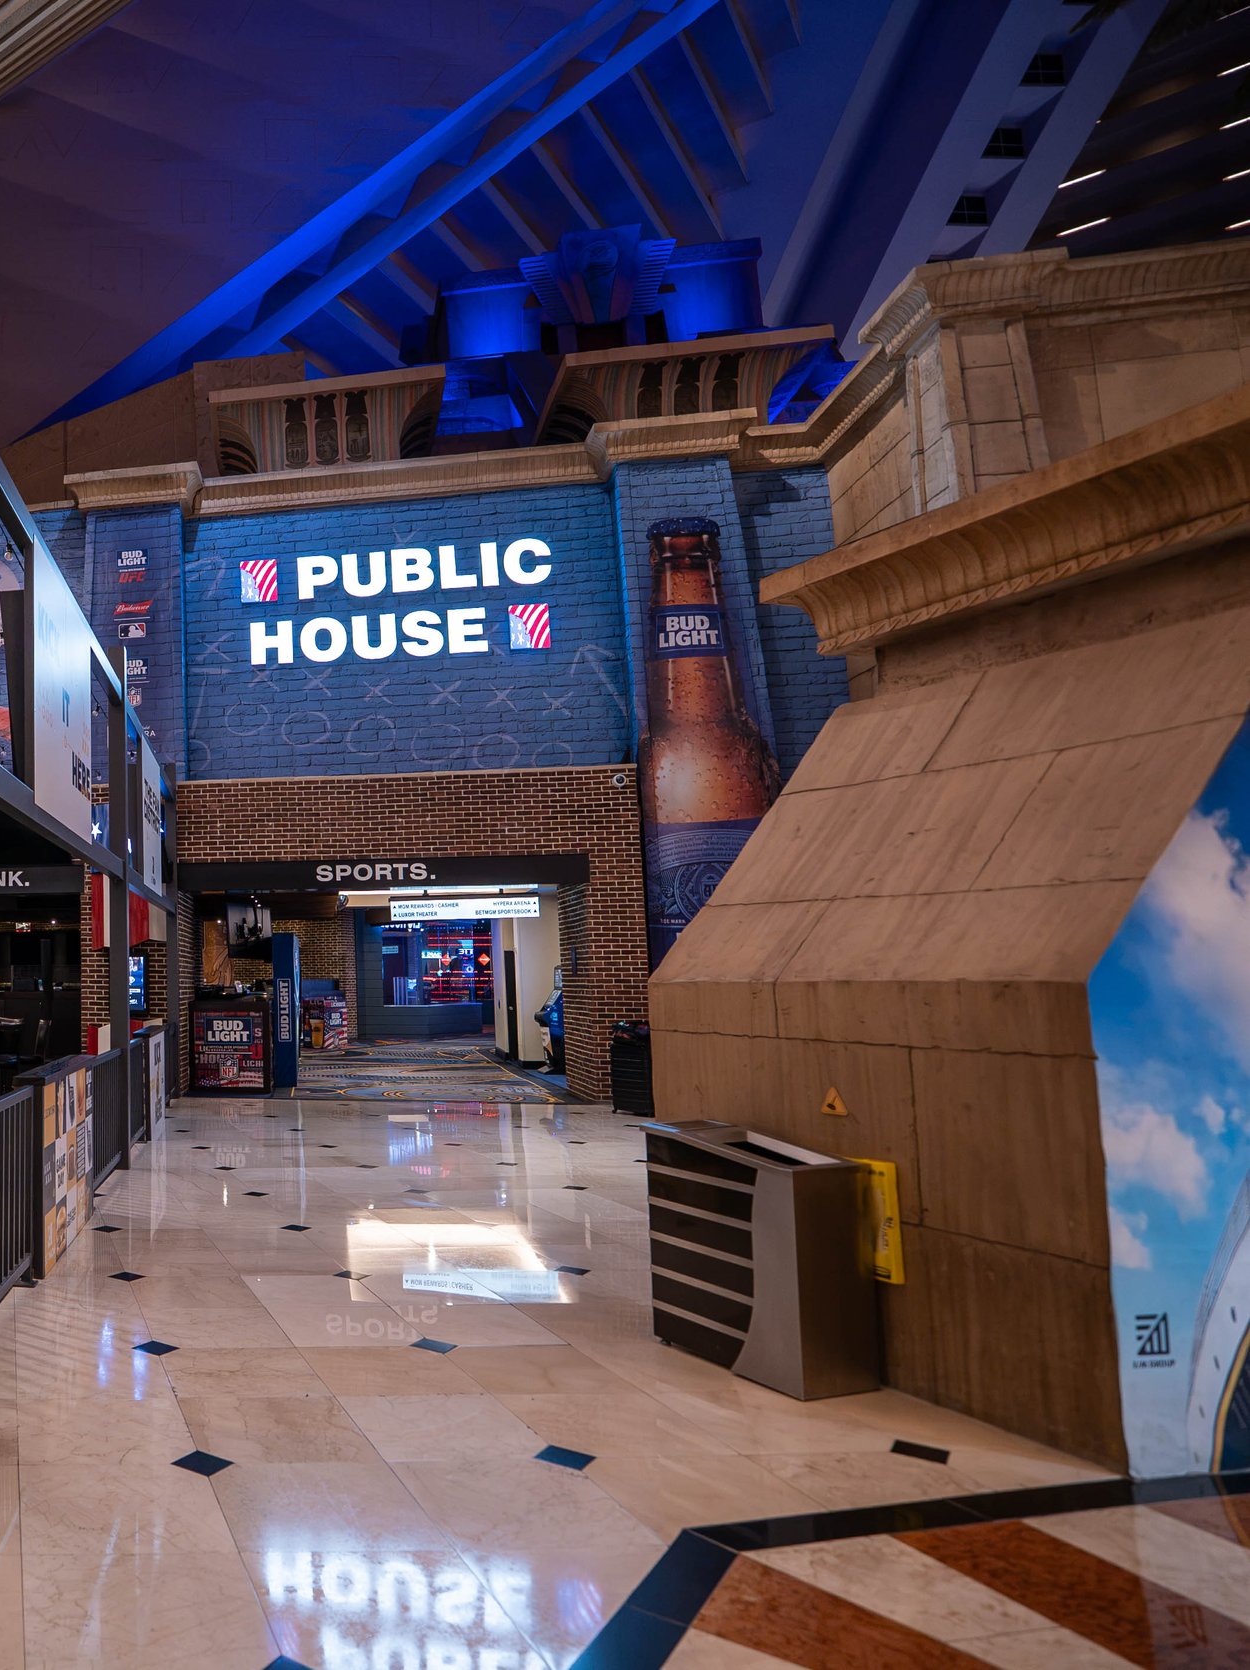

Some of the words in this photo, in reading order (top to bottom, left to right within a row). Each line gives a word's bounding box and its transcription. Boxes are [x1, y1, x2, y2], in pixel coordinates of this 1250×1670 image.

[117, 557, 147, 567] LIGHT
[121, 550, 143, 559] BUD
[119, 571, 147, 583] UFC
[297, 538, 552, 600] PUBLIC
[665, 615, 710, 632] BUD
[250, 607, 489, 665] HOUSE
[659, 630, 720, 648] LIGHT
[62, 687, 70, 728] IT
[72, 750, 91, 801] HERE
[316, 863, 436, 882] SPORTS.
[279, 981, 289, 1013] LIGHT
[213, 1020, 243, 1031] BUD
[280, 1016, 290, 1040] BUD
[207, 1031, 250, 1042] LIGHT
[221, 1067, 237, 1077] NFL
